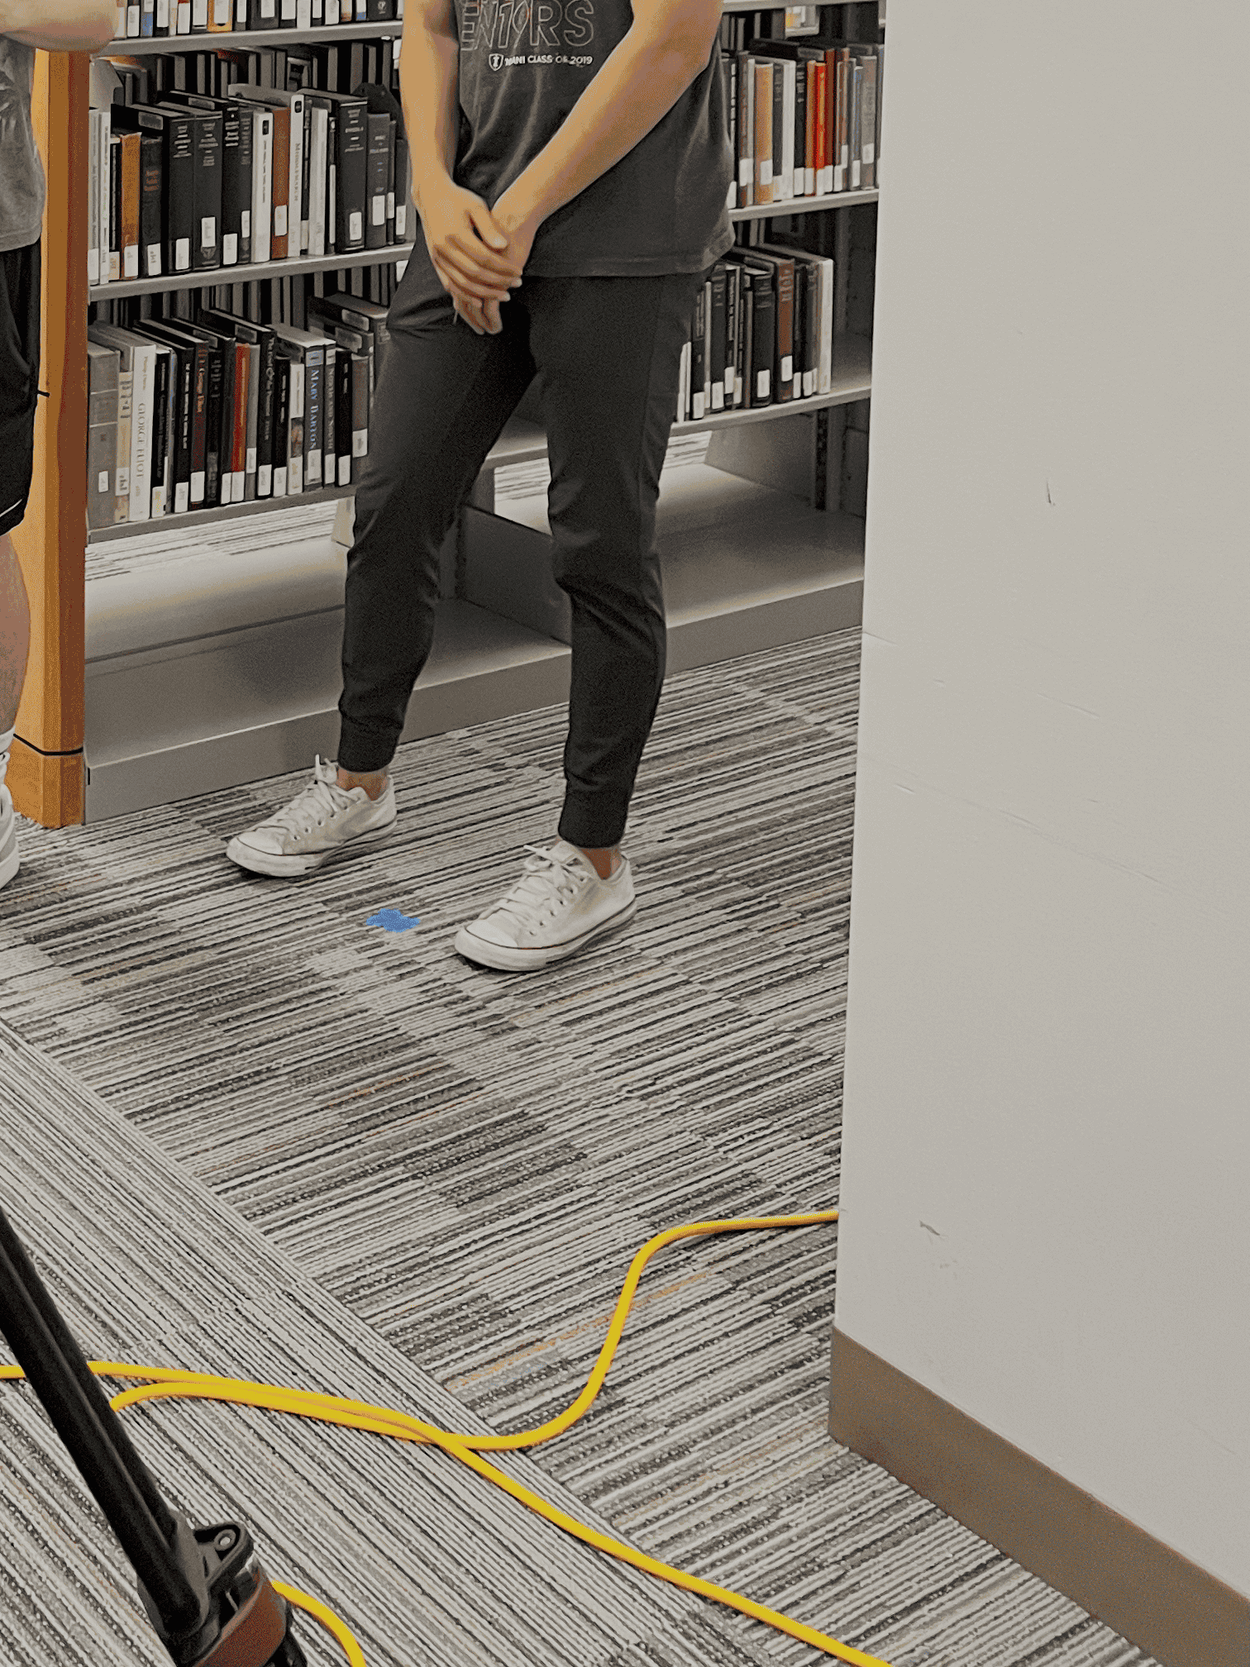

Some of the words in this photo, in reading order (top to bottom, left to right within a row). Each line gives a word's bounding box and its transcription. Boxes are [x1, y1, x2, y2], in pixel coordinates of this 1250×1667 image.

[527, 54, 553, 64] CLASS
[568, 55, 594, 65] 2019
[310, 369, 320, 401] MARY
[135, 402, 146, 446] GEORGE
[309, 404, 320, 451] BARTON
[134, 448, 145, 479] ELIOT
